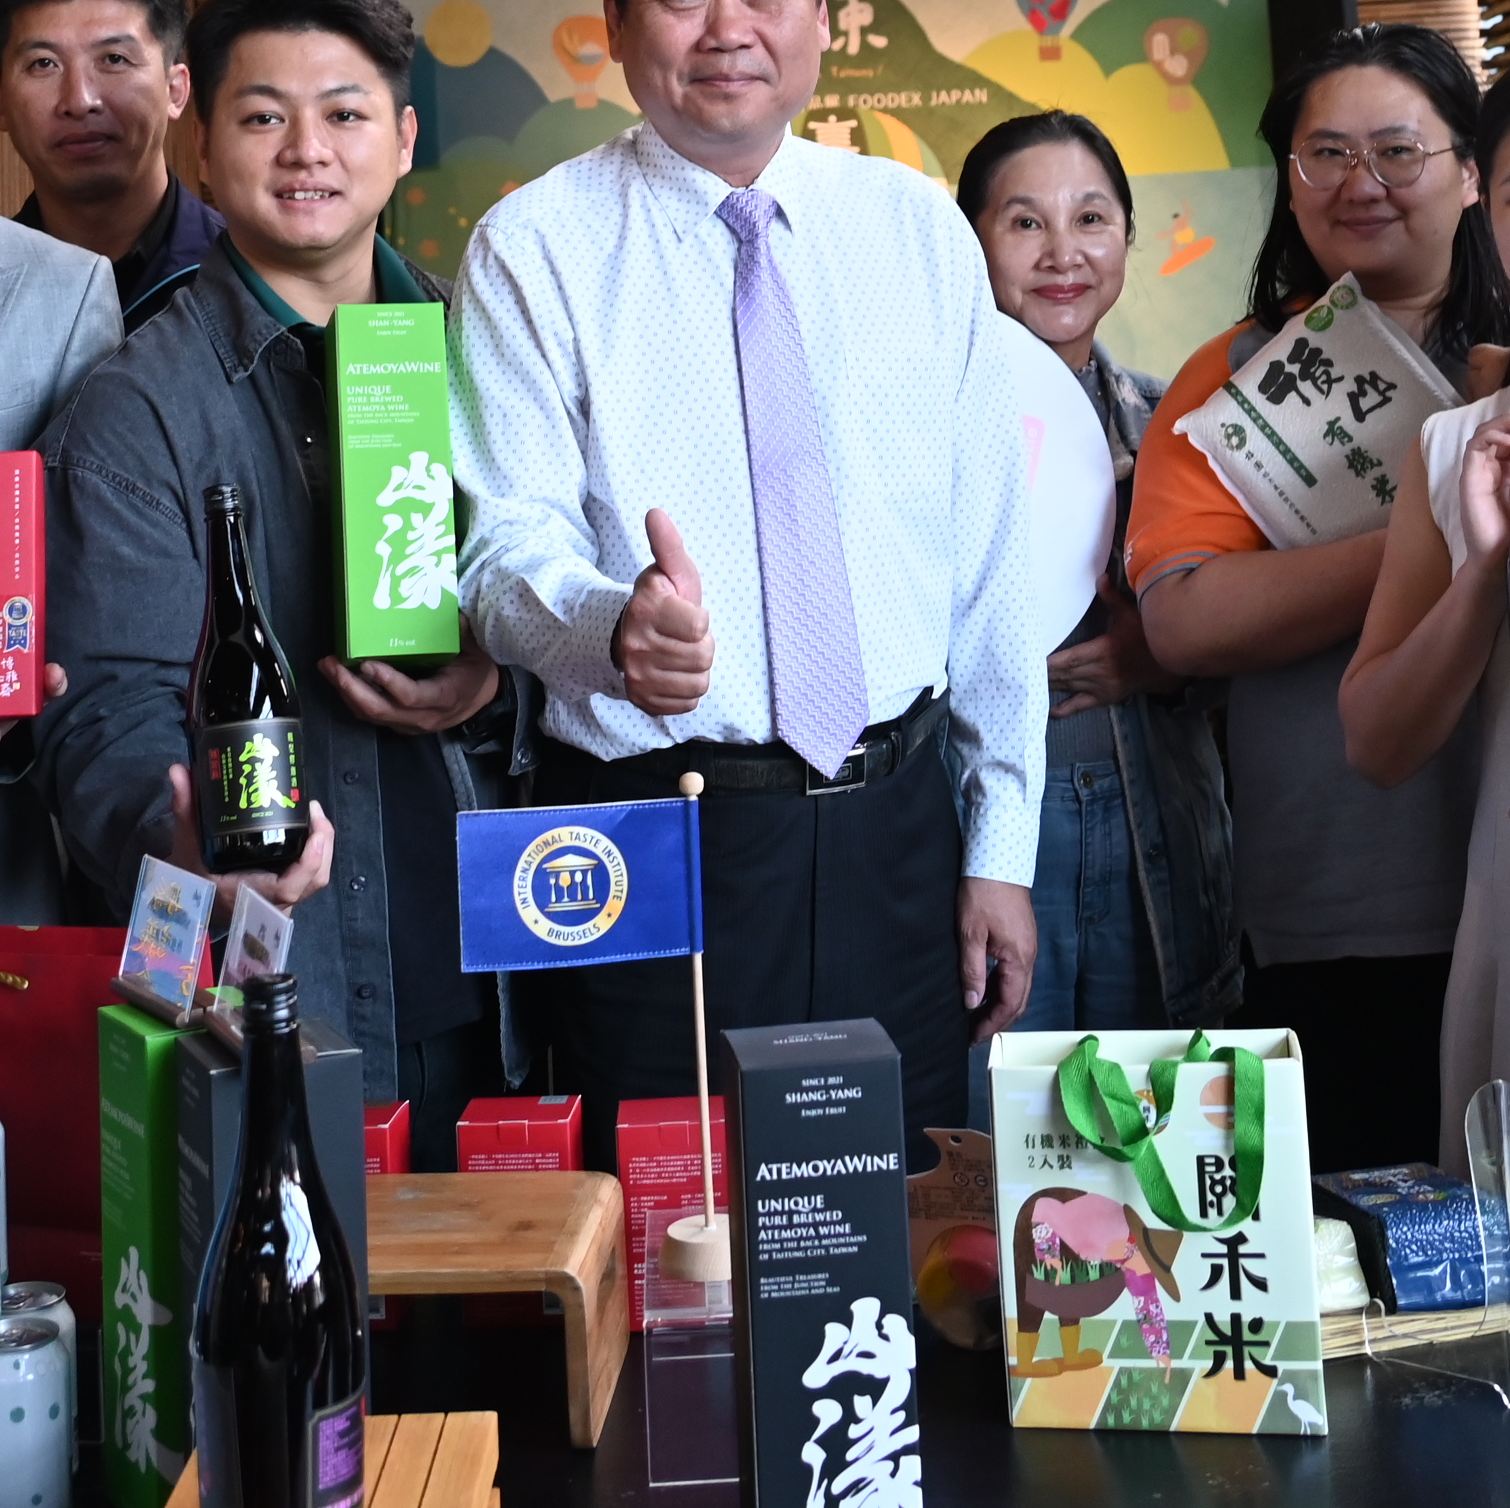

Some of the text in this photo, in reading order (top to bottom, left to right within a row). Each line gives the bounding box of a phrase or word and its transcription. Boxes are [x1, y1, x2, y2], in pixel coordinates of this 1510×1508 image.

[848, 91, 923, 110] FOODEX
[930, 88, 988, 106] JAPAN
[347, 385, 392, 396] UNIQUE
[370, 395, 403, 403] BREWED
[347, 404, 385, 412] ATEMOYA
[517, 830, 624, 910] INTERNATIONAL TASTE INSTITUTE
[546, 922, 601, 942] BRUSSELS
[801, 1078, 825, 1087] SINCE
[825, 1106, 847, 1115] FRUIT
[1027, 1153, 1073, 1171] 2入裝
[757, 1194, 825, 1213] UNIQUE
[758, 1210, 843, 1227] PURE BREWED
[758, 1223, 852, 1241] ATEMOYA WINE
[759, 1235, 867, 1251] FROM THE BACK MOUNTAINS
[759, 1253, 769, 1261] OF
[772, 1250, 806, 1260] TAITUNG
[829, 1245, 858, 1255] TAIWAN
